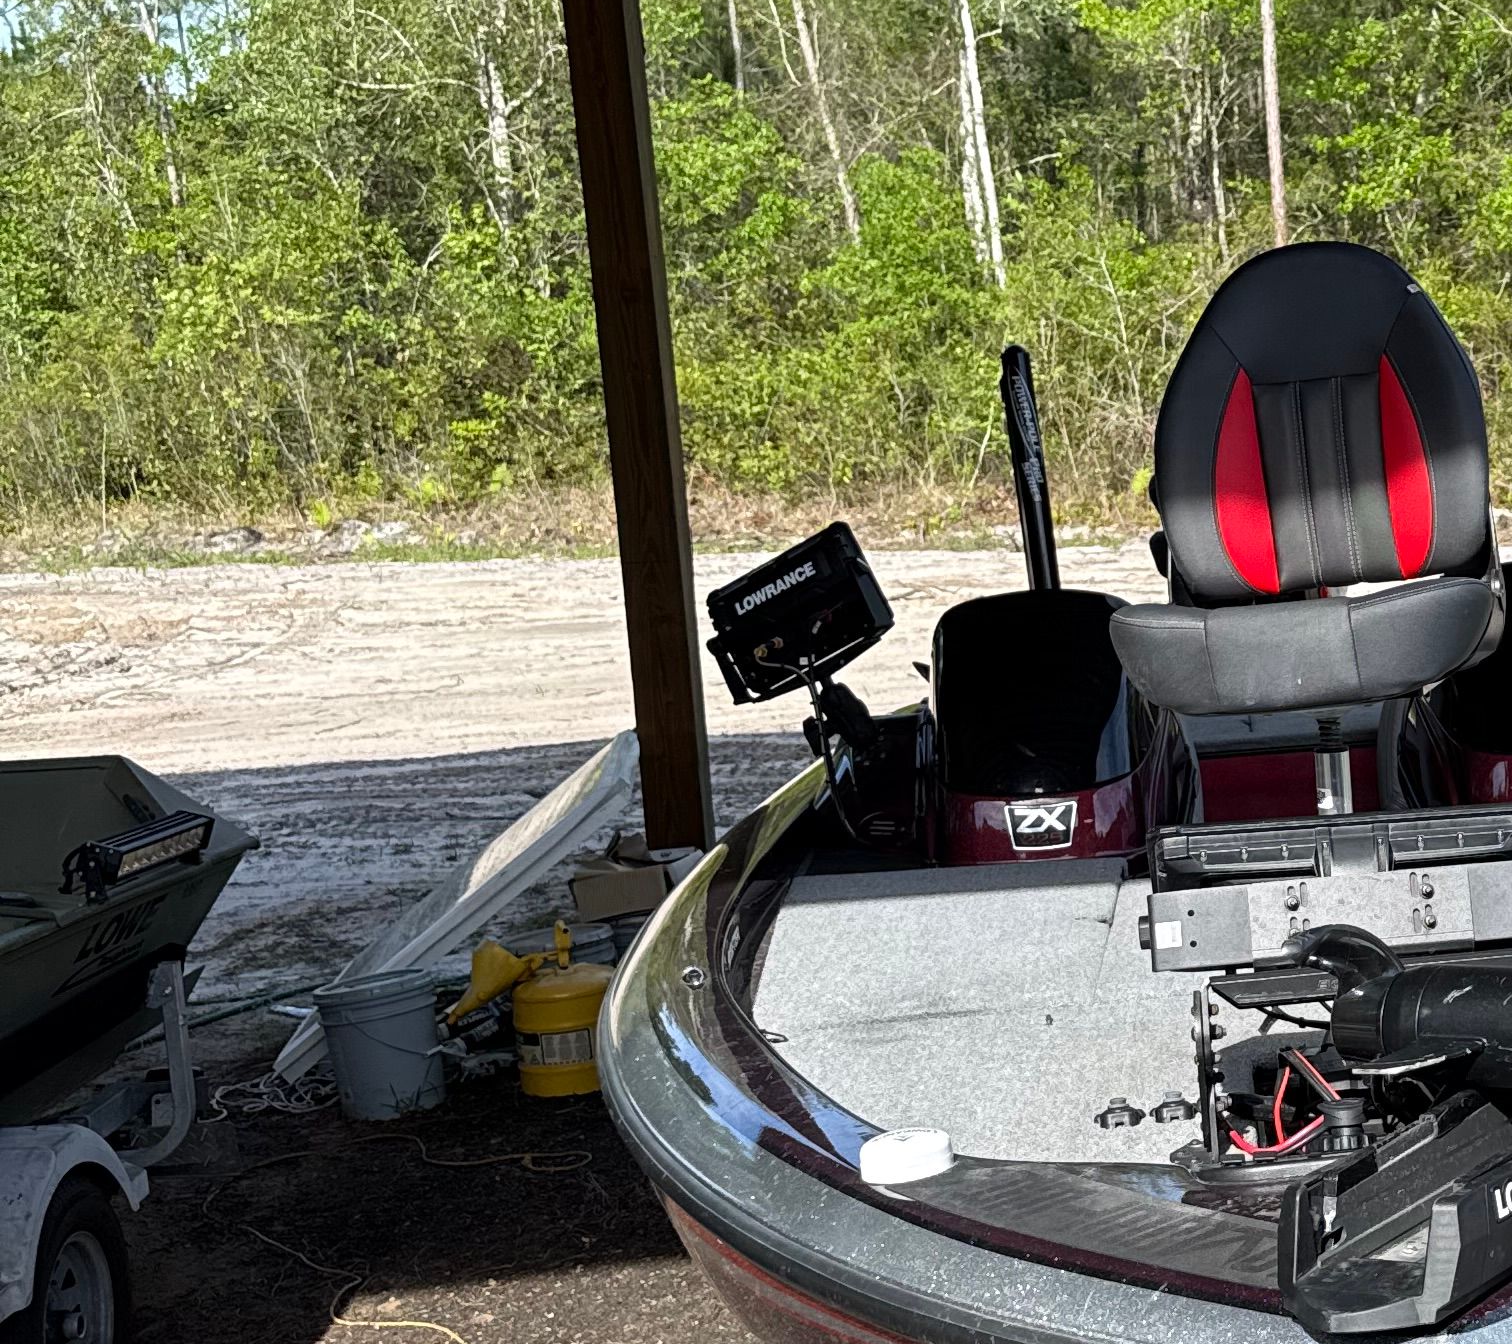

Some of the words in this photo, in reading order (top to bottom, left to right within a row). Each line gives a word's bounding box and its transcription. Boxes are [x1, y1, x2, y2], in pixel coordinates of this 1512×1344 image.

[1029, 457, 1044, 483] PRO
[734, 561, 816, 616] LOWRANCE
[1014, 805, 1067, 833] ZX
[73, 894, 168, 964] LOWE
